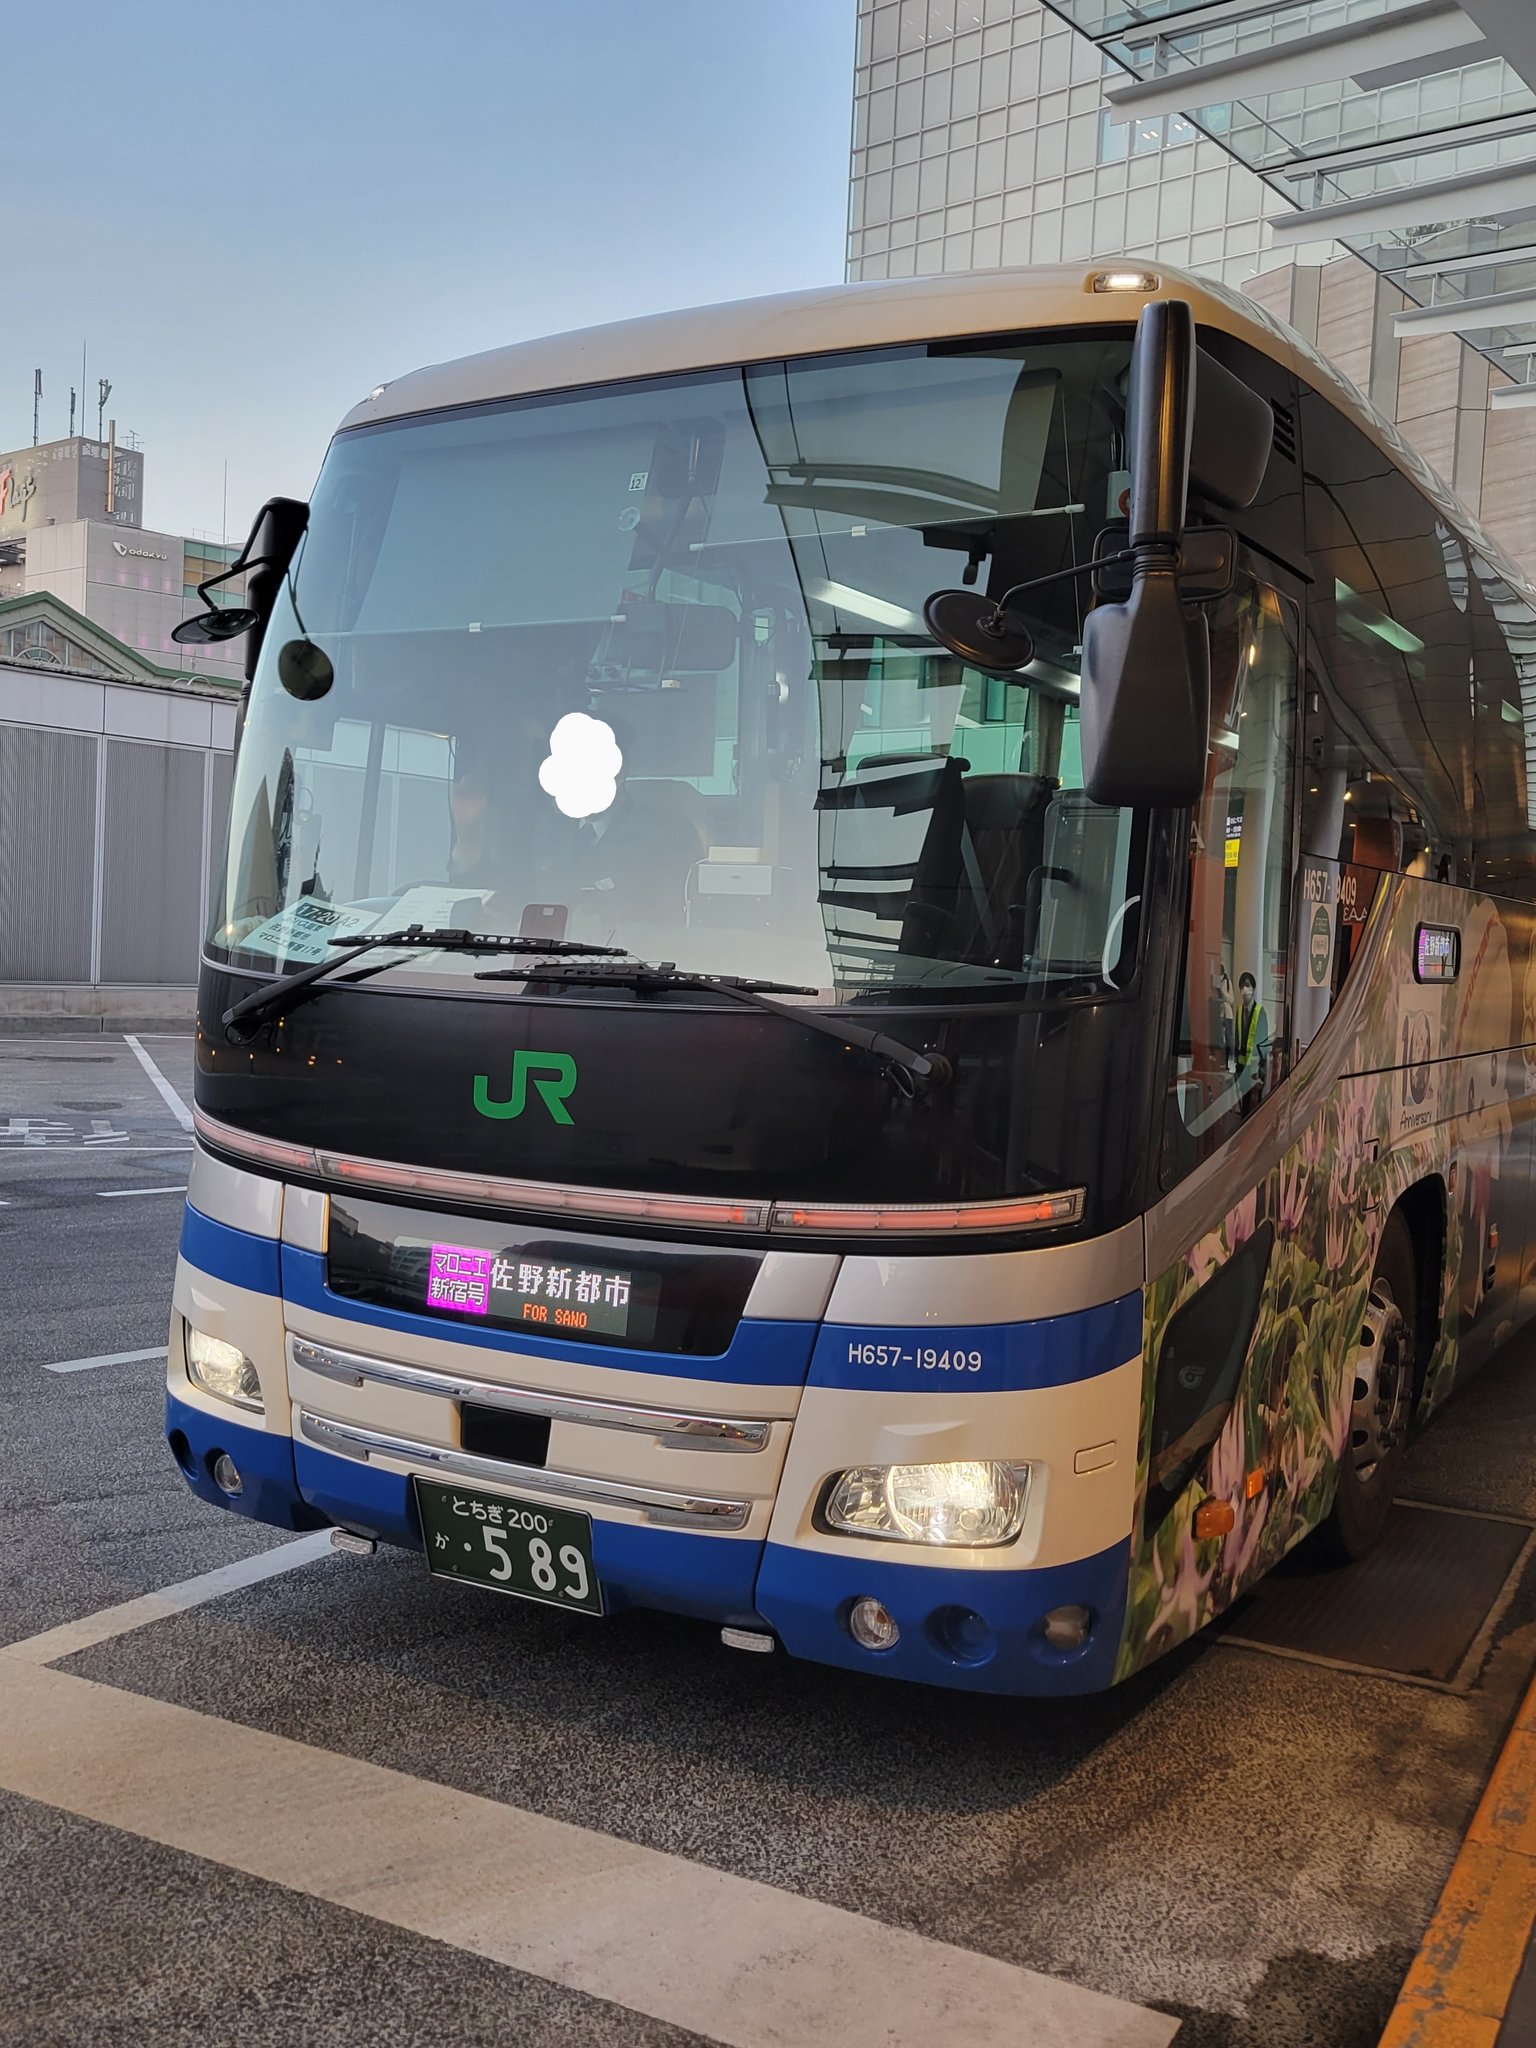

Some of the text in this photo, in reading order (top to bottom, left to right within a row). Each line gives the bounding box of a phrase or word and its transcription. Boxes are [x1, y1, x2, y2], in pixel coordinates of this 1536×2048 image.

[129, 549, 167, 560] odakyu
[298, 905, 360, 928] 17:20 A2
[473, 1049, 577, 1125] JR
[1400, 1110, 1432, 1130] Anniversary
[433, 1252, 487, 1278] マロニエ
[430, 1276, 485, 1306] 新宿号
[490, 1258, 632, 1308] 佐野新都市
[523, 1303, 587, 1329] FOR SANO
[848, 1343, 982, 1372] H657-19409
[435, 1532, 450, 1550] か
